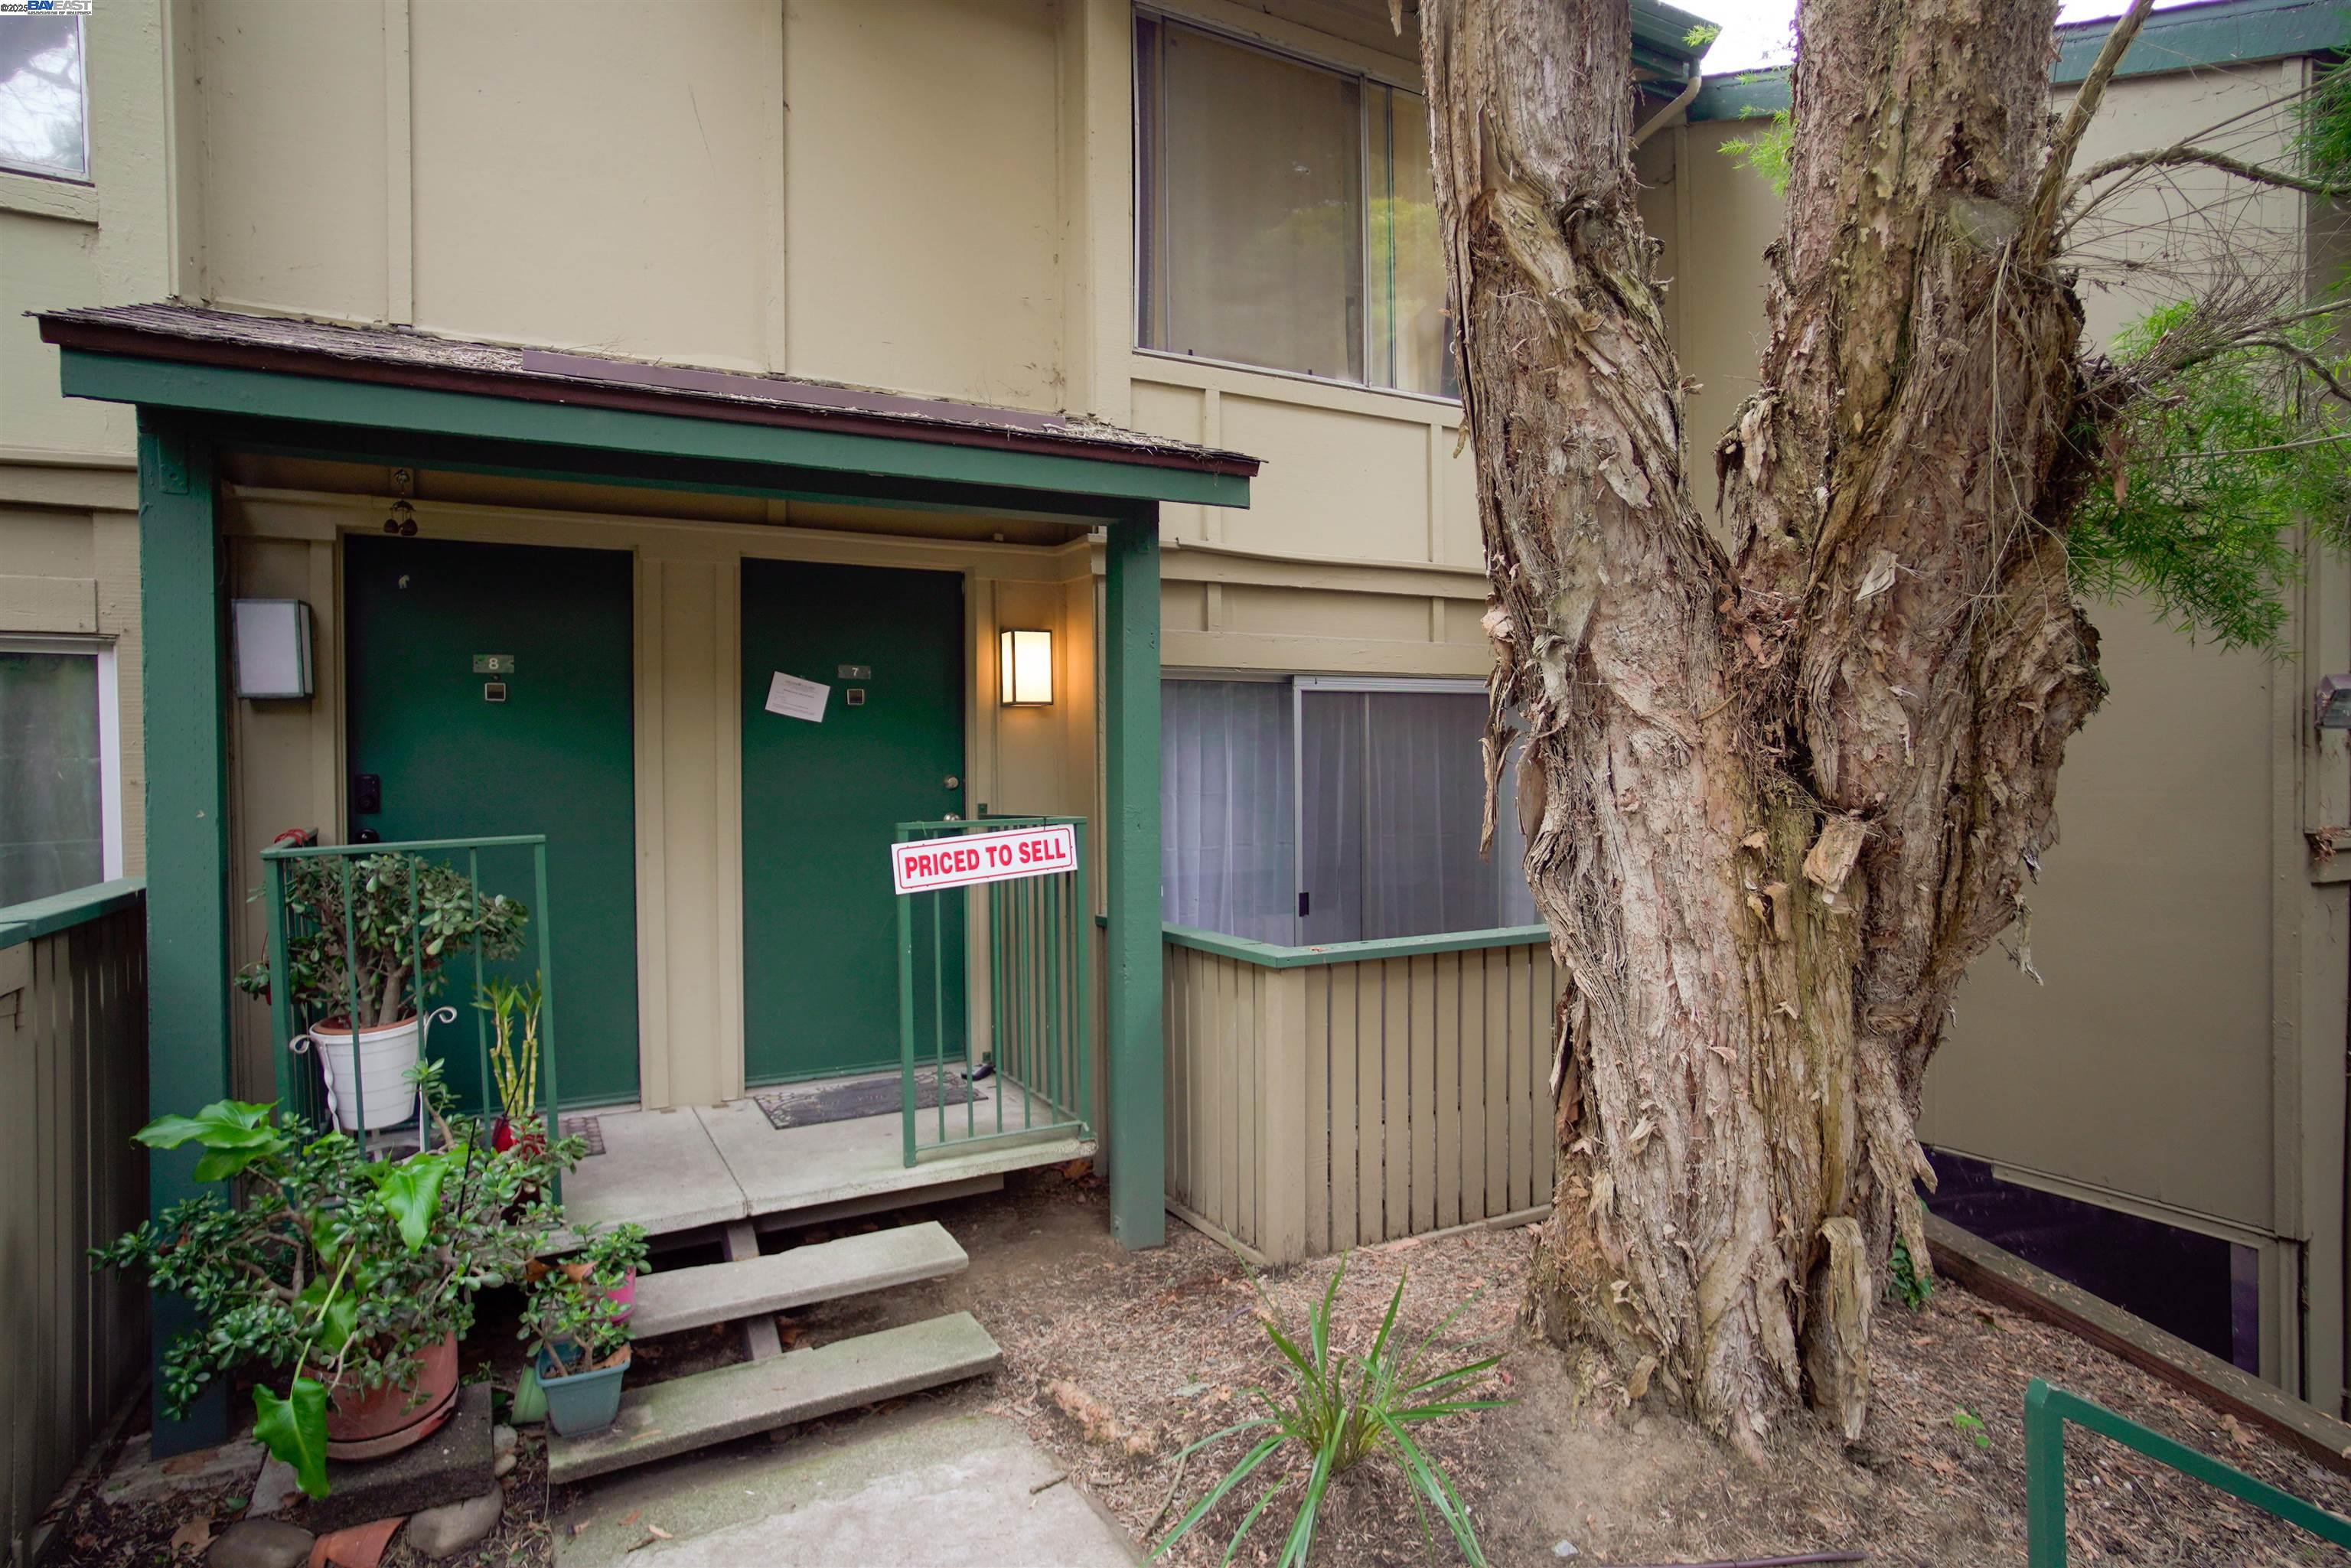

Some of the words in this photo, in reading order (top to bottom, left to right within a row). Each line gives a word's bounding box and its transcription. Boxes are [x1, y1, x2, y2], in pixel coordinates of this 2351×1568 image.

[488, 657, 499, 670] 8
[851, 667, 859, 676] 7
[905, 848, 980, 879] PRICED
[986, 844, 1012, 868] TO
[1019, 838, 1066, 864] SELL
